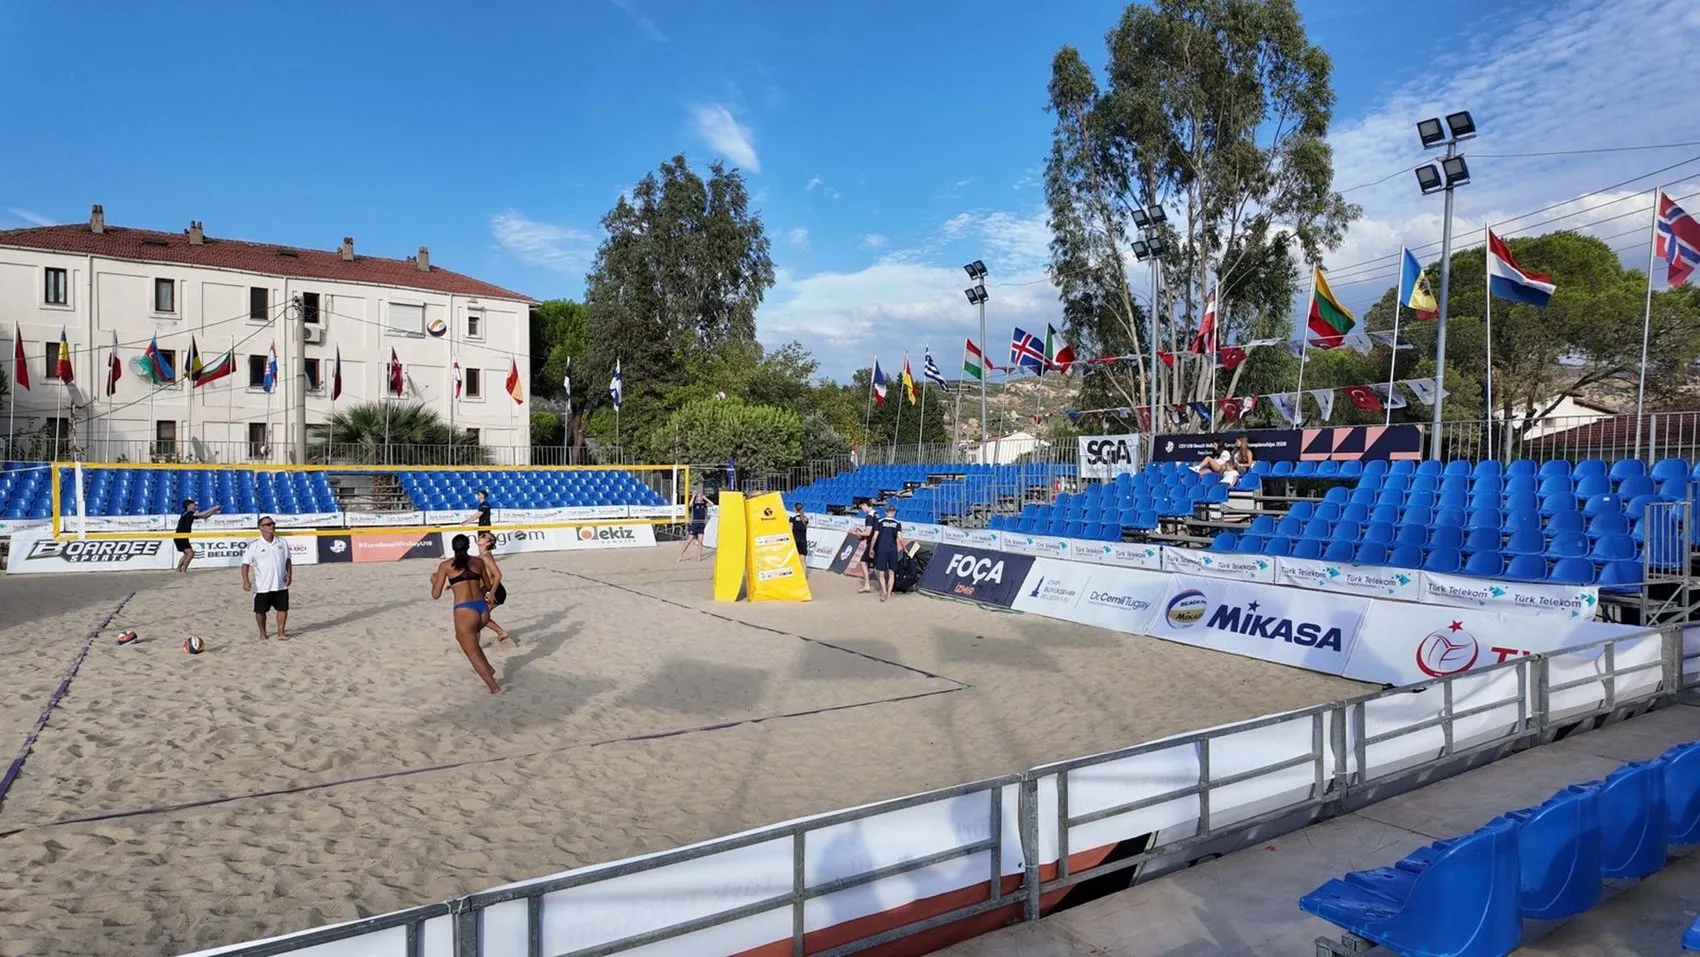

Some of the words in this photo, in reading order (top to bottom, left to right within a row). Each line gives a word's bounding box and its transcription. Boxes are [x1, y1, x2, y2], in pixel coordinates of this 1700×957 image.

[1087, 440, 1132, 465] SGA
[26, 540, 161, 560] BOARDEE
[945, 553, 1004, 585] FOÇA
[1232, 562, 1257, 570] Telekom
[1280, 566, 1296, 574] Türk
[1298, 568, 1326, 578] Telekom
[1346, 574, 1362, 583] Türk
[1365, 576, 1396, 586] Telekom
[1427, 583, 1446, 592] Türk
[1449, 586, 1488, 598] Telekom
[1514, 594, 1536, 604] Türk
[1539, 597, 1582, 608] Telekom
[1207, 603, 1342, 652] MIKASA
